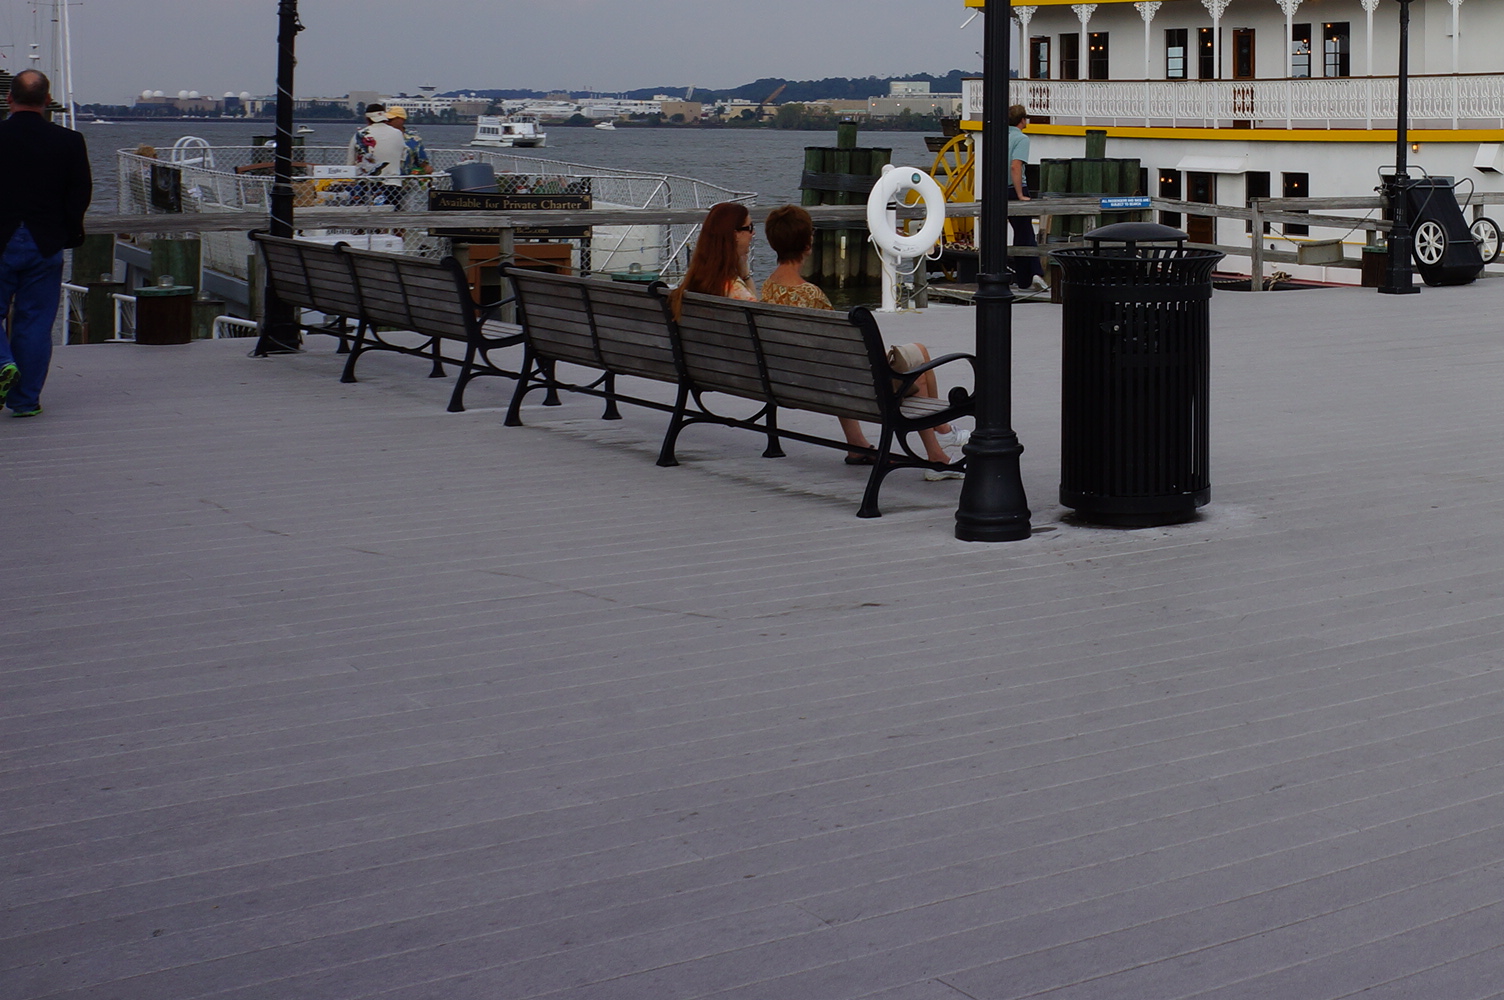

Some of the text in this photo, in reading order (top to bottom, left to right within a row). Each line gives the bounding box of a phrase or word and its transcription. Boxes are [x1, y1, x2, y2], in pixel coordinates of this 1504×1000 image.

[438, 197, 582, 210] Available for Private Charter
